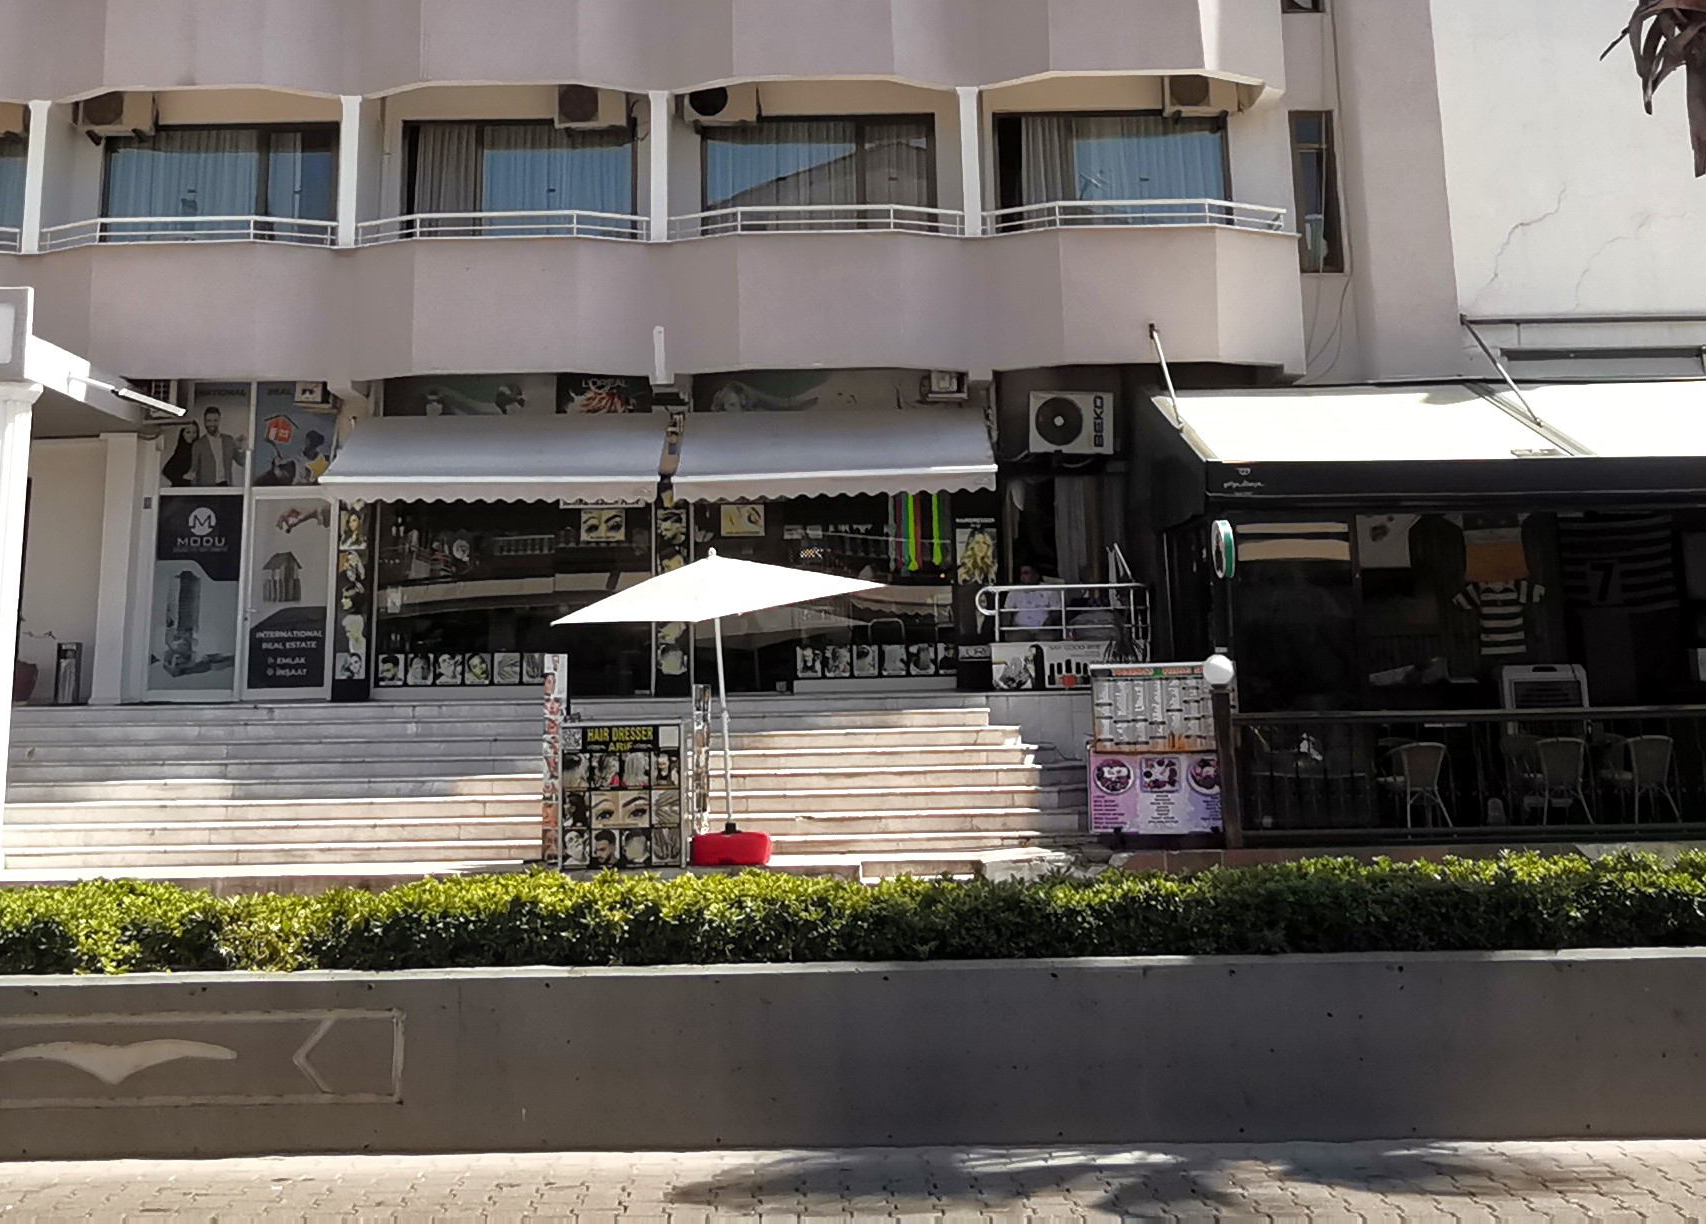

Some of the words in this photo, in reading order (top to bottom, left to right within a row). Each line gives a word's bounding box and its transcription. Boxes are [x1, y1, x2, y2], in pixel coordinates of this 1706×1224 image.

[1093, 395, 1104, 447] BEKO
[177, 536, 225, 547] MODU
[255, 630, 323, 639] INTERNATIONAL
[262, 641, 284, 650] REAL
[285, 640, 317, 649] ESTATE
[611, 726, 654, 741] DRESSER
